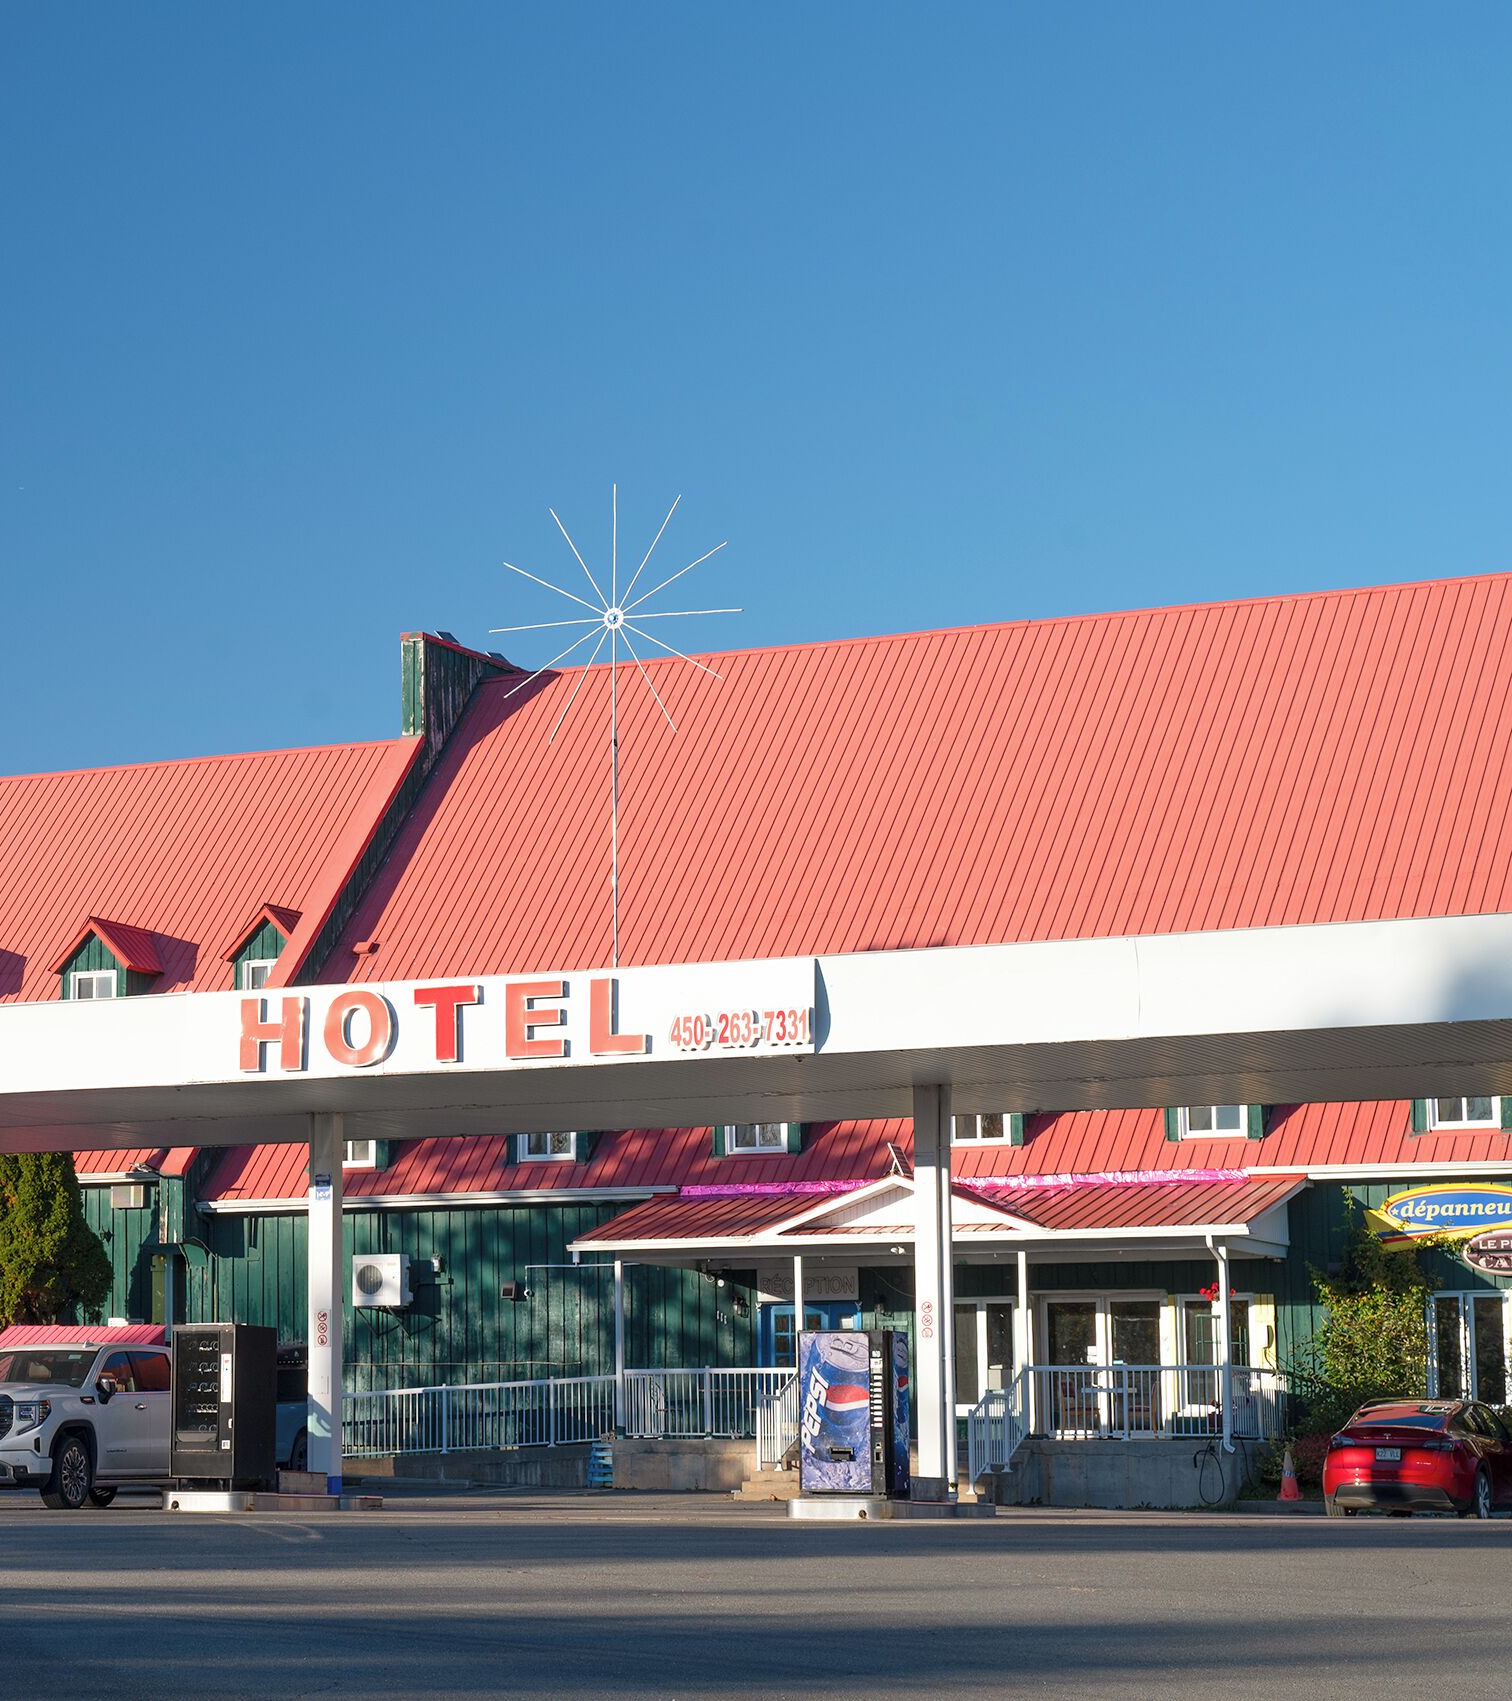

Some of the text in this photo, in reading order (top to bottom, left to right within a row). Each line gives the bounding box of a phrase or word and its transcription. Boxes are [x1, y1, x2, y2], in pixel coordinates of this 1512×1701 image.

[239, 978, 649, 1072] HOTEL
[1479, 1239, 1512, 1250] LE P
[1478, 1256, 1512, 1268] CA
[759, 1273, 856, 1295] RÉCPTION
[801, 1366, 830, 1454] PEPSI
